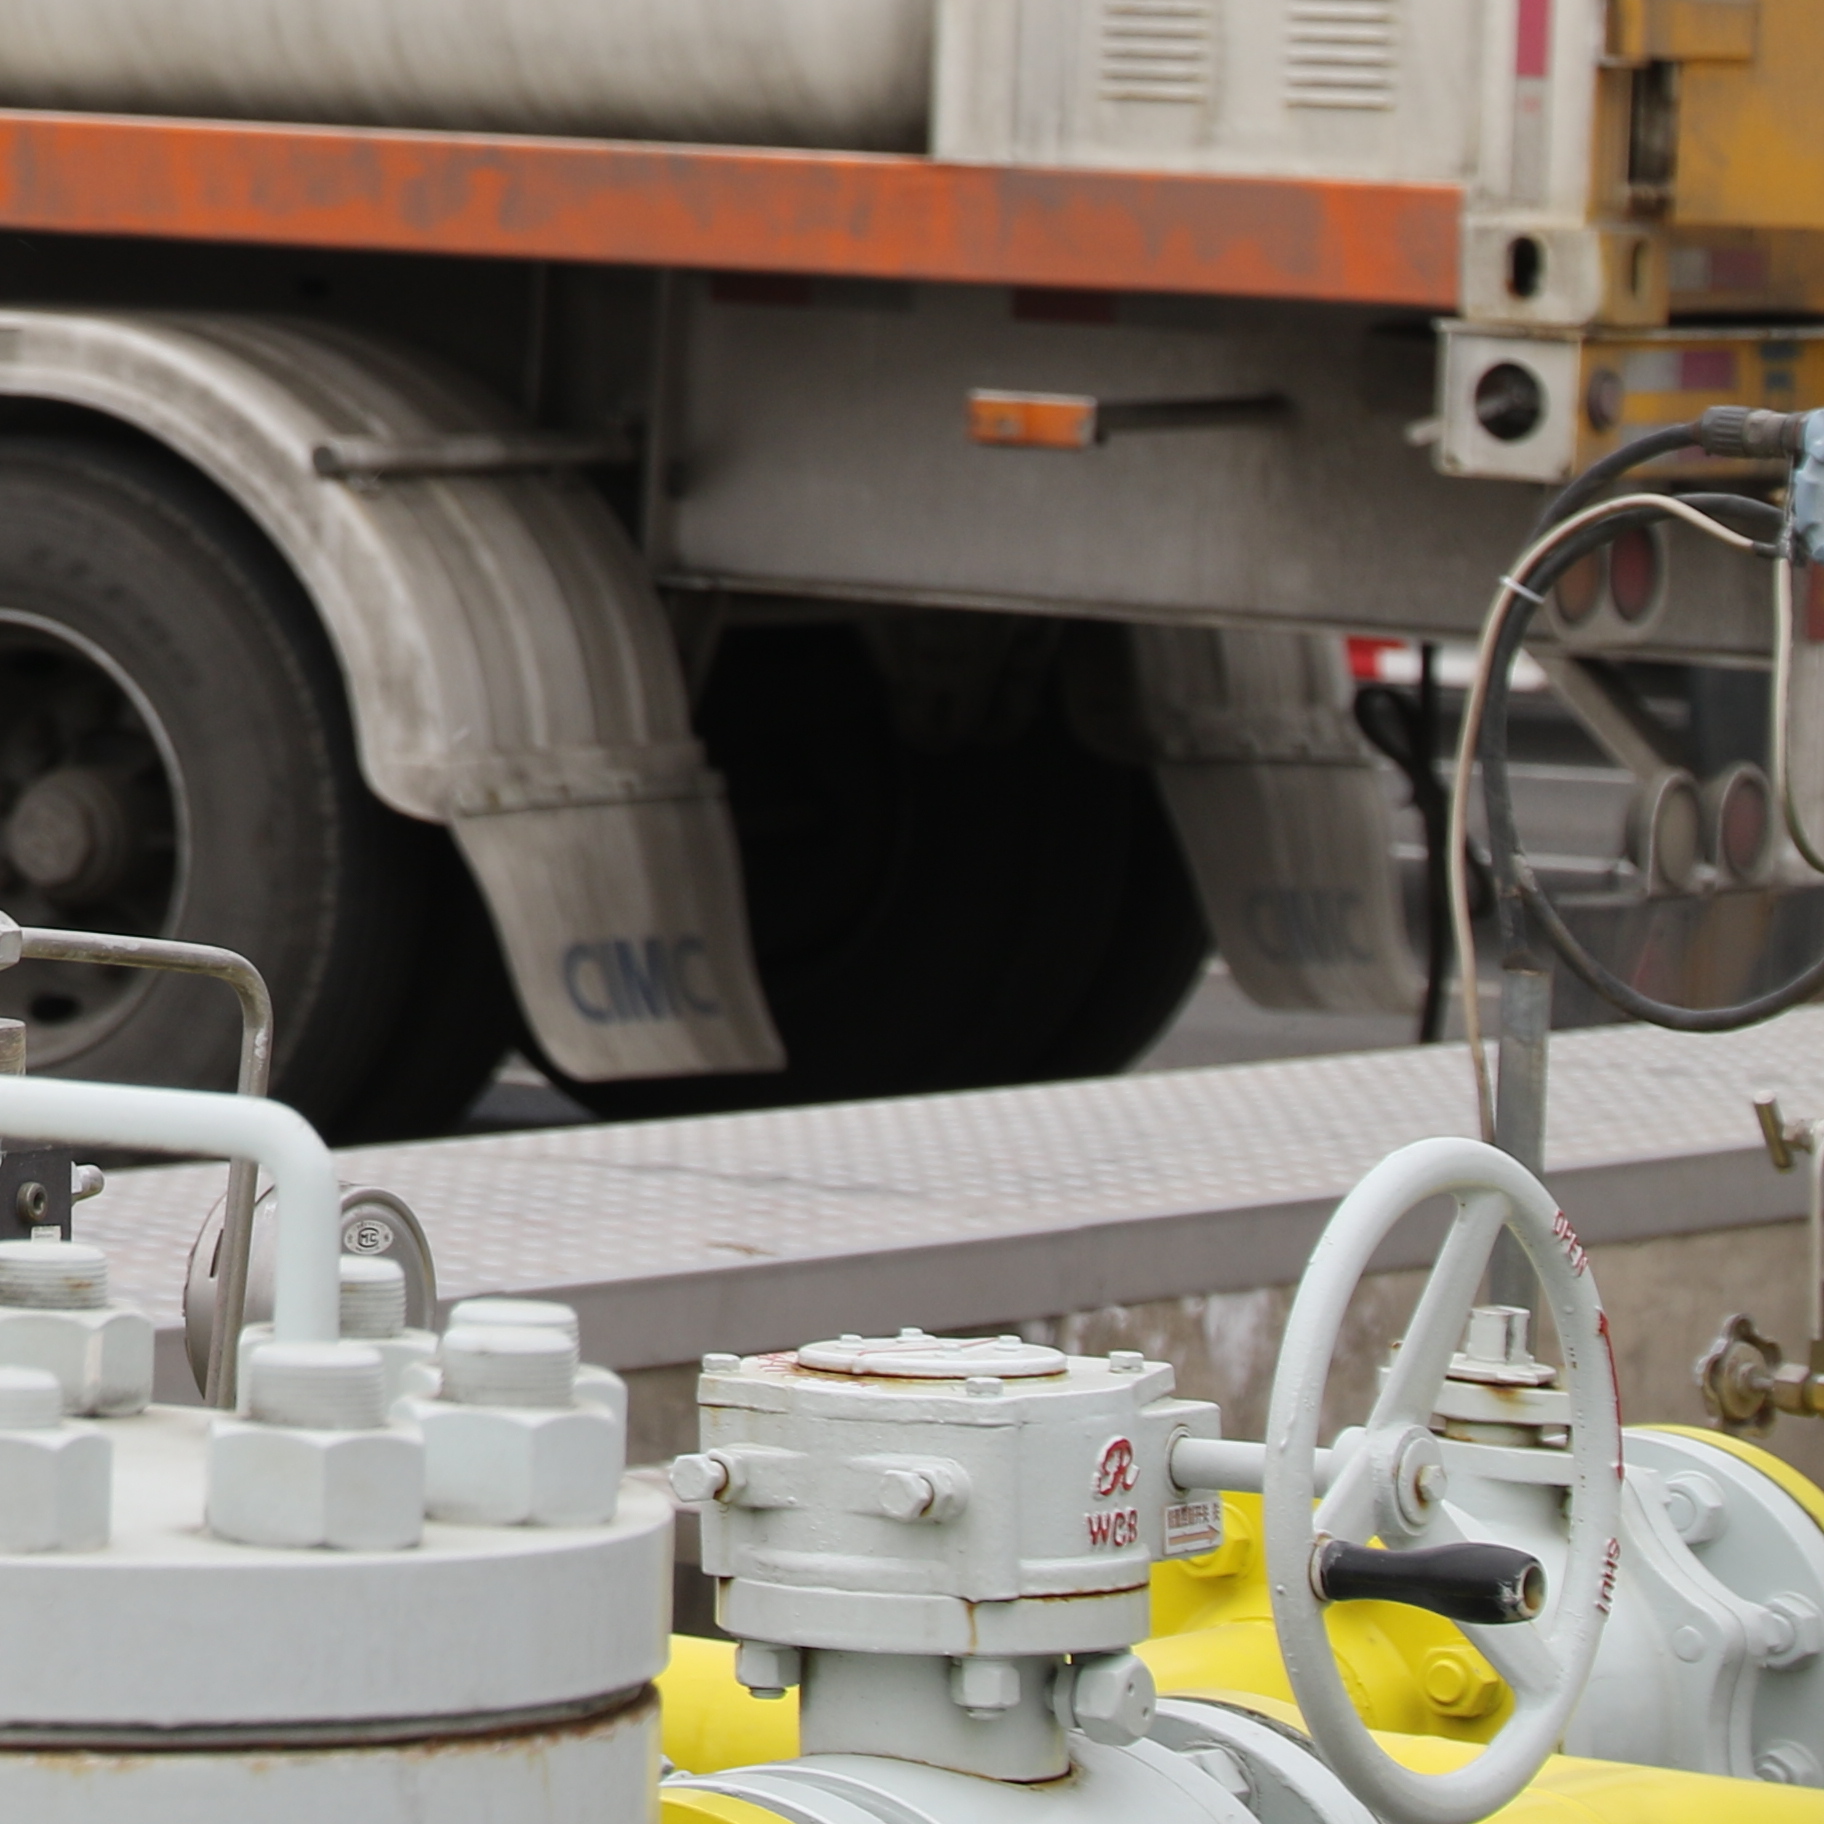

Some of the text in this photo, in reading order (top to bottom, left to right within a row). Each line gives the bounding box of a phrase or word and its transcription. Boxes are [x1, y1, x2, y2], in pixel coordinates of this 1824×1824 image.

[562, 934, 722, 1024] CIMC
[1553, 1209, 1590, 1276] OPEN
[1086, 1508, 1139, 1547] WCB
